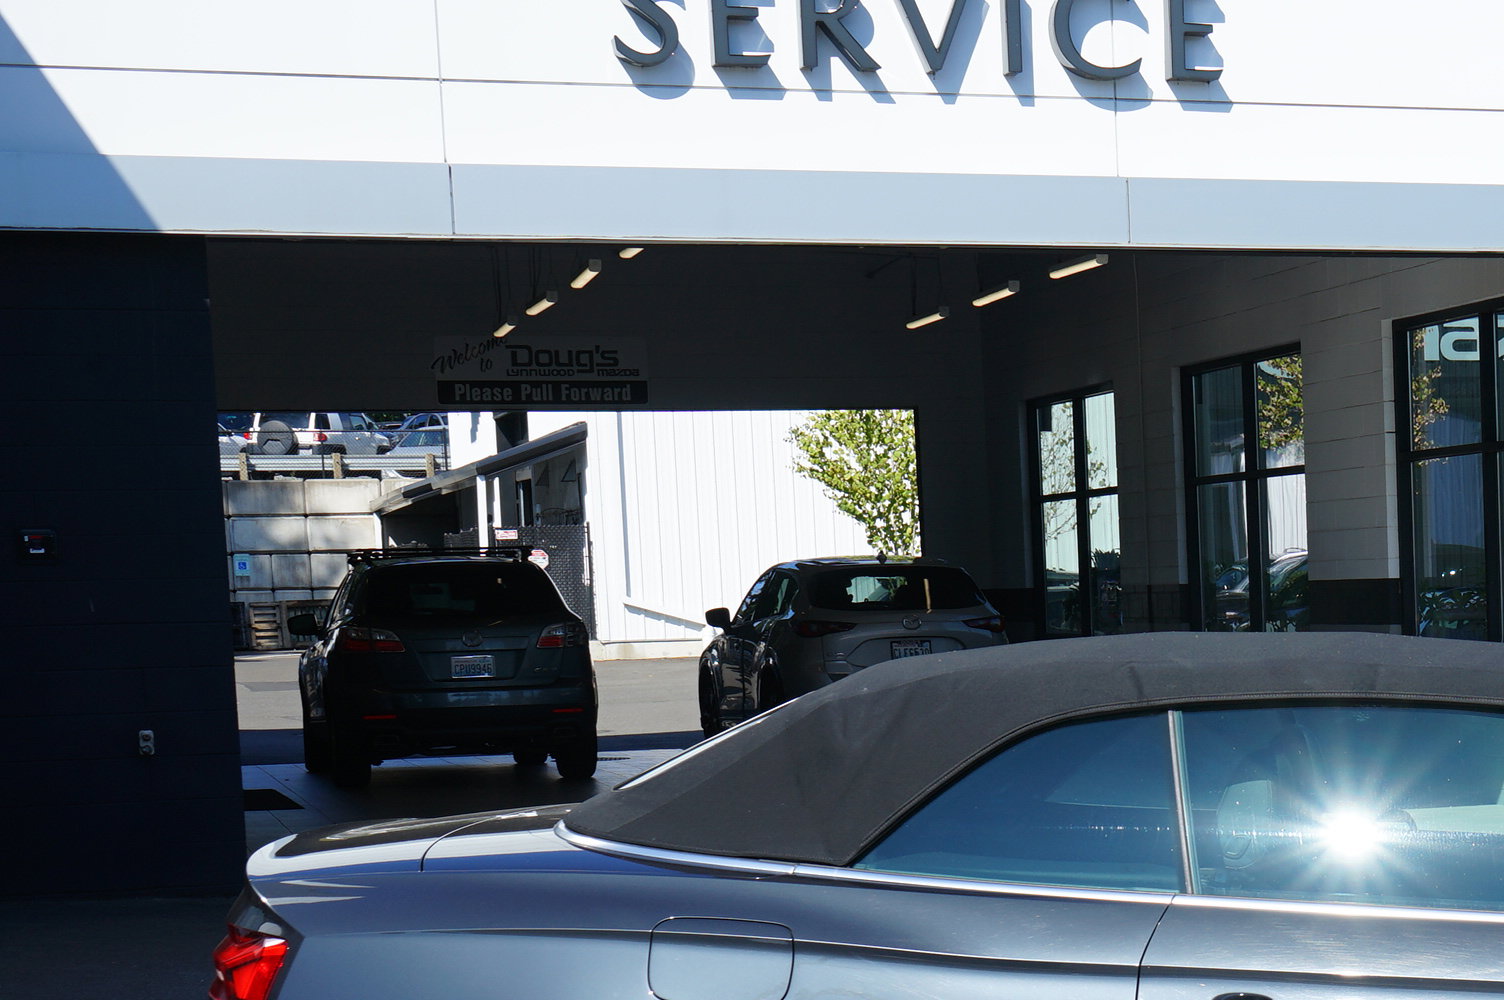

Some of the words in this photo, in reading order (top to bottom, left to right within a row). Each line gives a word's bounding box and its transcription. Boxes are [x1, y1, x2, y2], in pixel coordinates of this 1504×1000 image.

[613, 0, 1223, 83] SERVICE
[480, 358, 493, 373] to
[505, 345, 619, 373] Doug's
[454, 384, 513, 401] Please
[521, 384, 553, 401] Pull
[561, 384, 631, 401] Forward
